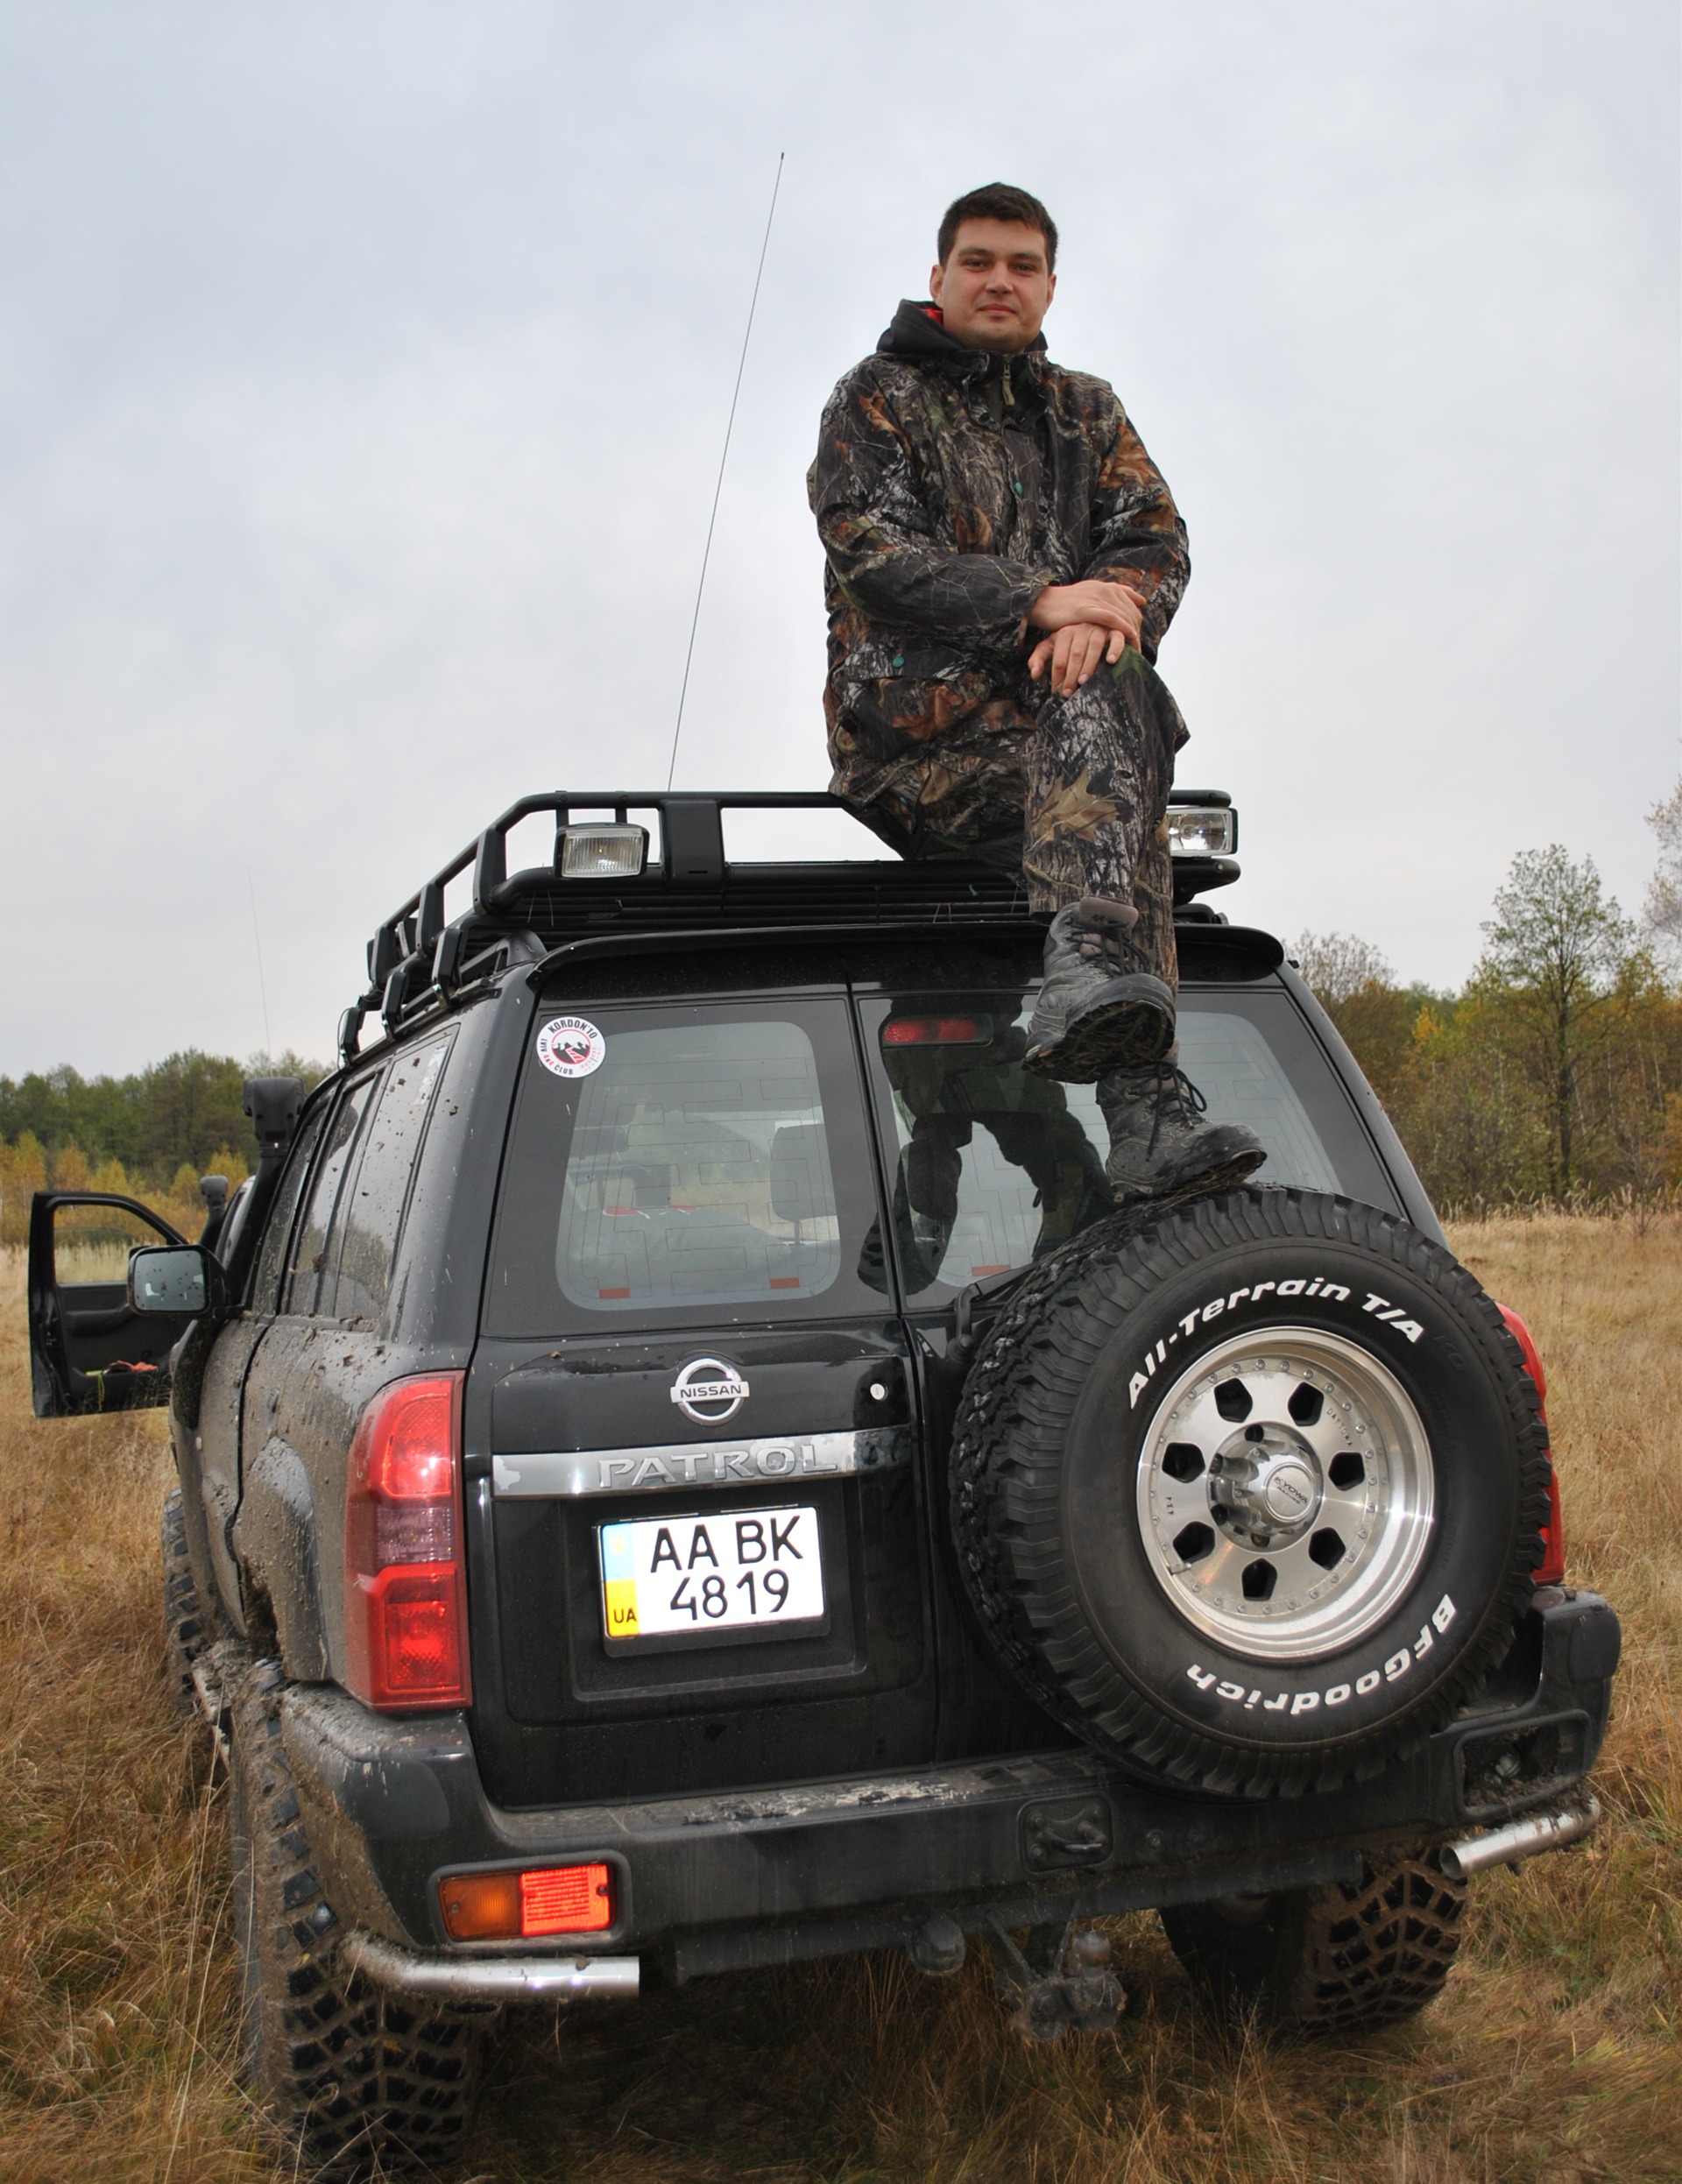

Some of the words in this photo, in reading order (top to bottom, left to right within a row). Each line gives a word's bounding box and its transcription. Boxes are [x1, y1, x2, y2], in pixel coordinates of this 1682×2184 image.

[548, 1019, 597, 1040] KORDON'10
[554, 1064, 574, 1076] CLUB
[1128, 1276, 1352, 1410] All-Terrain
[1360, 1292, 1424, 1344] T/A
[679, 1383, 742, 1398] NISSAN
[1325, 1407, 1353, 1448] DAYTONA
[598, 1443, 838, 1488] PATROL
[1273, 1475, 1309, 1505] KYOWA
[650, 1523, 719, 1573] AA
[736, 1515, 803, 1566] BK
[613, 1606, 636, 1624] UA
[669, 1568, 789, 1621] 4819
[1187, 1594, 1457, 1715] BFGoodrich
